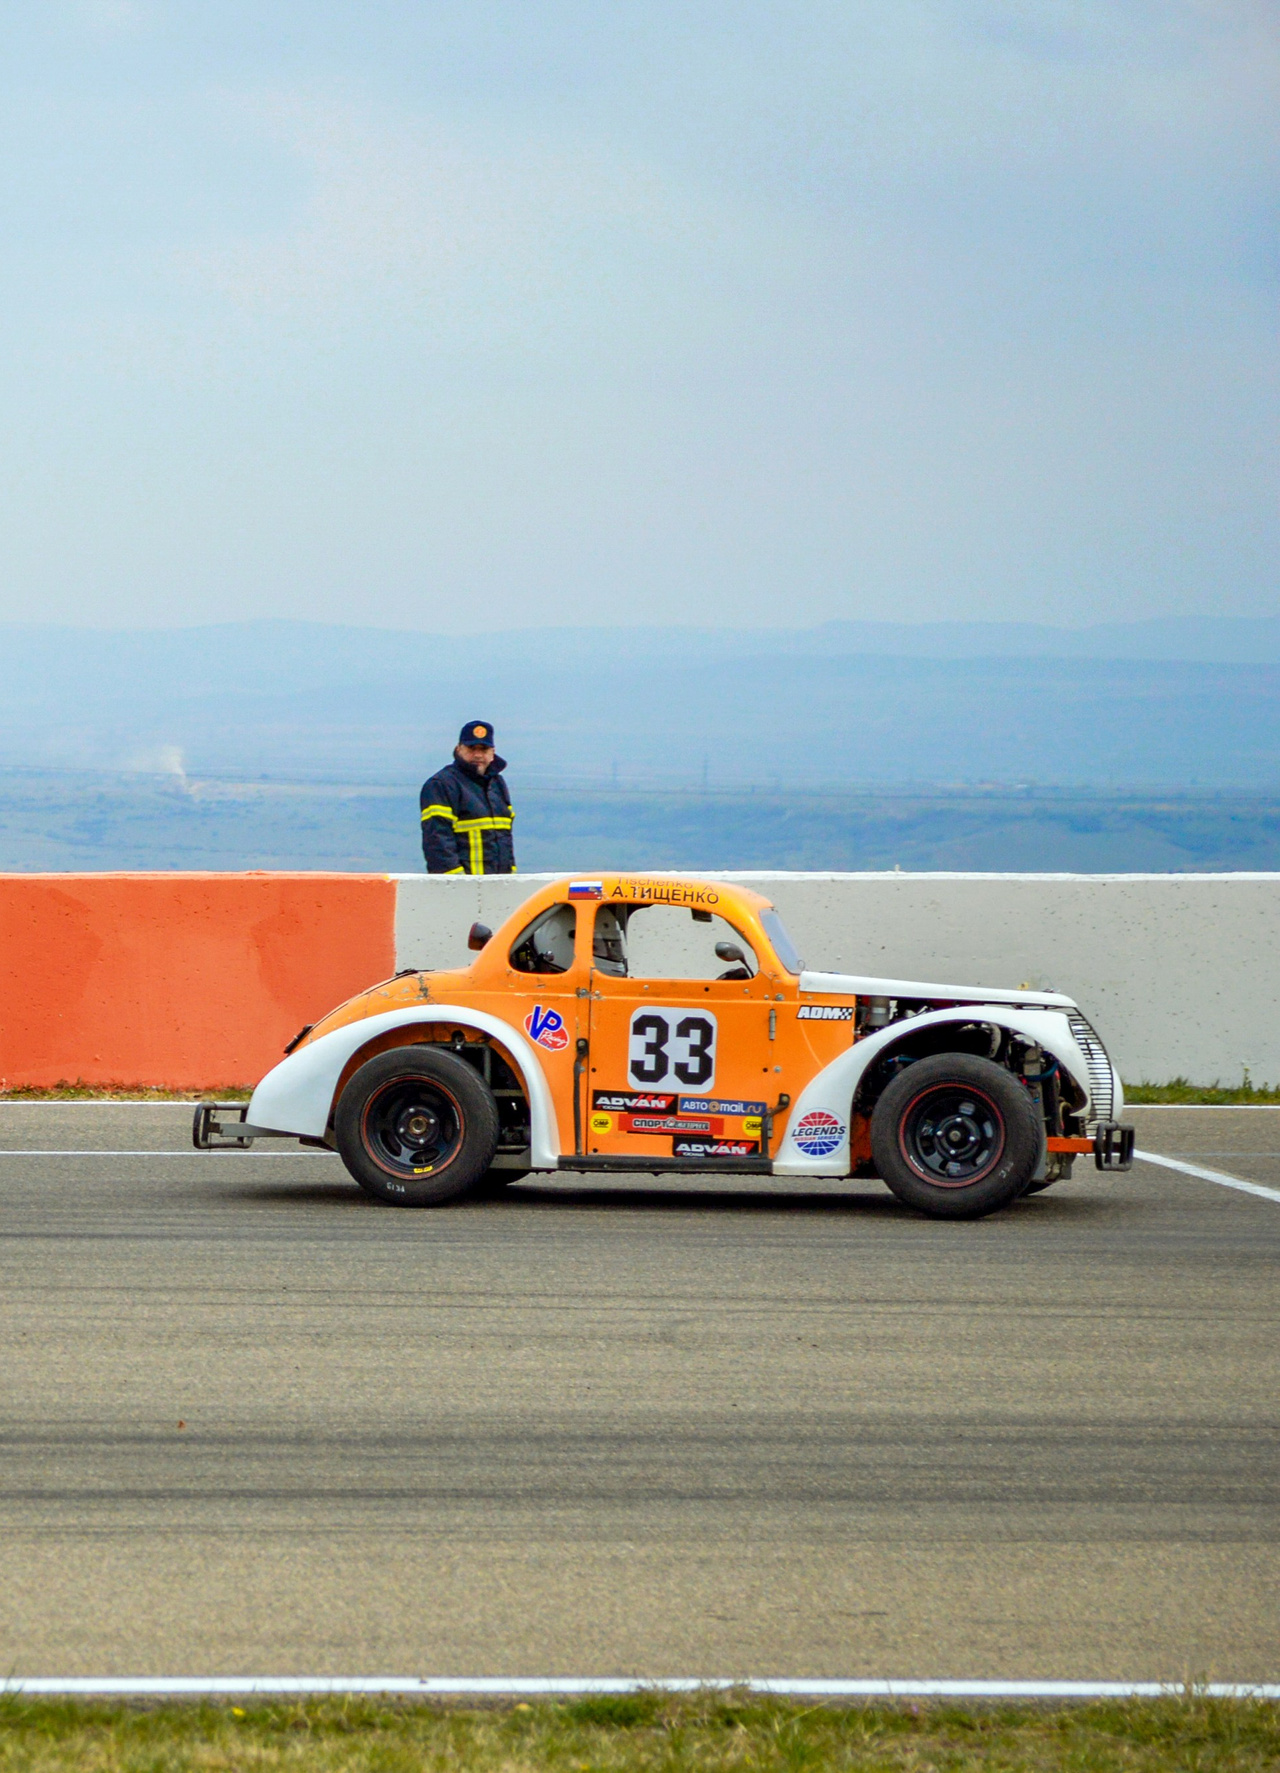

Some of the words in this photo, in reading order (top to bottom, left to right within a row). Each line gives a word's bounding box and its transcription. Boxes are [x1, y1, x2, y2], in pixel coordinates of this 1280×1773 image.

[616, 876, 694, 889] Tischenko
[797, 1006, 841, 1019] ADM
[530, 1005, 562, 1041] VP
[630, 1014, 713, 1085] 33
[595, 1096, 667, 1109] ADVAN
[593, 1119, 609, 1127] OMP
[792, 1126, 846, 1137] LEGENDS
[676, 1143, 747, 1155] ADVAN
